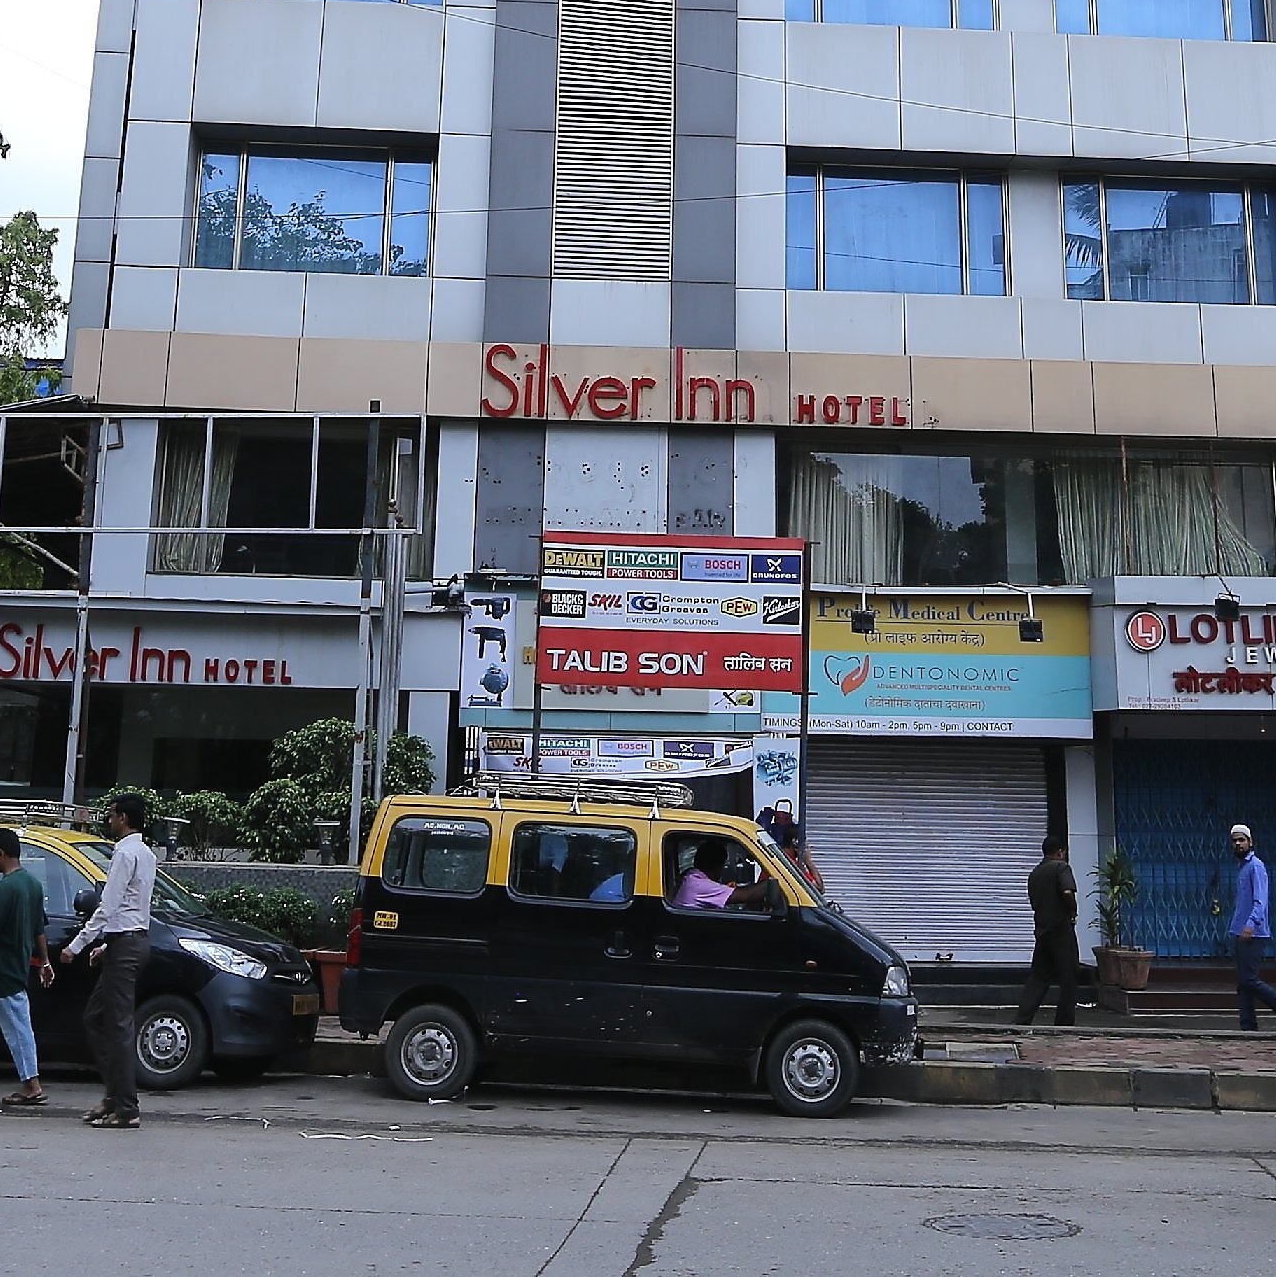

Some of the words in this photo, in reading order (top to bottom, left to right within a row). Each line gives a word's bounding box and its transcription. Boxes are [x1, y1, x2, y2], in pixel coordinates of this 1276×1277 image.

[481, 344, 656, 420] Silver
[674, 345, 755, 423] Inn
[796, 394, 908, 426] HOTEL
[612, 551, 675, 566] HITACHI
[705, 559, 741, 570] BOSCH
[612, 569, 644, 578] POWER
[645, 570, 674, 579] TOOLS
[752, 572, 798, 580] GRUNDFOS
[588, 593, 623, 611] SKIL
[662, 595, 719, 605] Crompton
[551, 604, 583, 615] DECKER
[726, 600, 752, 614] PEW
[888, 598, 960, 621] Medical
[626, 617, 669, 625] EVERYDAY
[673, 618, 719, 626] SOLUTIONS
[129, 626, 192, 683] Inn
[204, 658, 292, 685] HOTEL
[546, 648, 628, 673] TALIB
[638, 652, 705, 675] SON
[769, 657, 792, 672] सन
[873, 665, 1020, 682] DENTONOMIC
[809, 718, 853, 730] (Mon-Sat)
[855, 719, 879, 729] 10am
[913, 720, 932, 731] 5pm
[940, 721, 959, 731] 9pm
[538, 739, 588, 748] HITACHI
[513, 757, 543, 769] SKL
